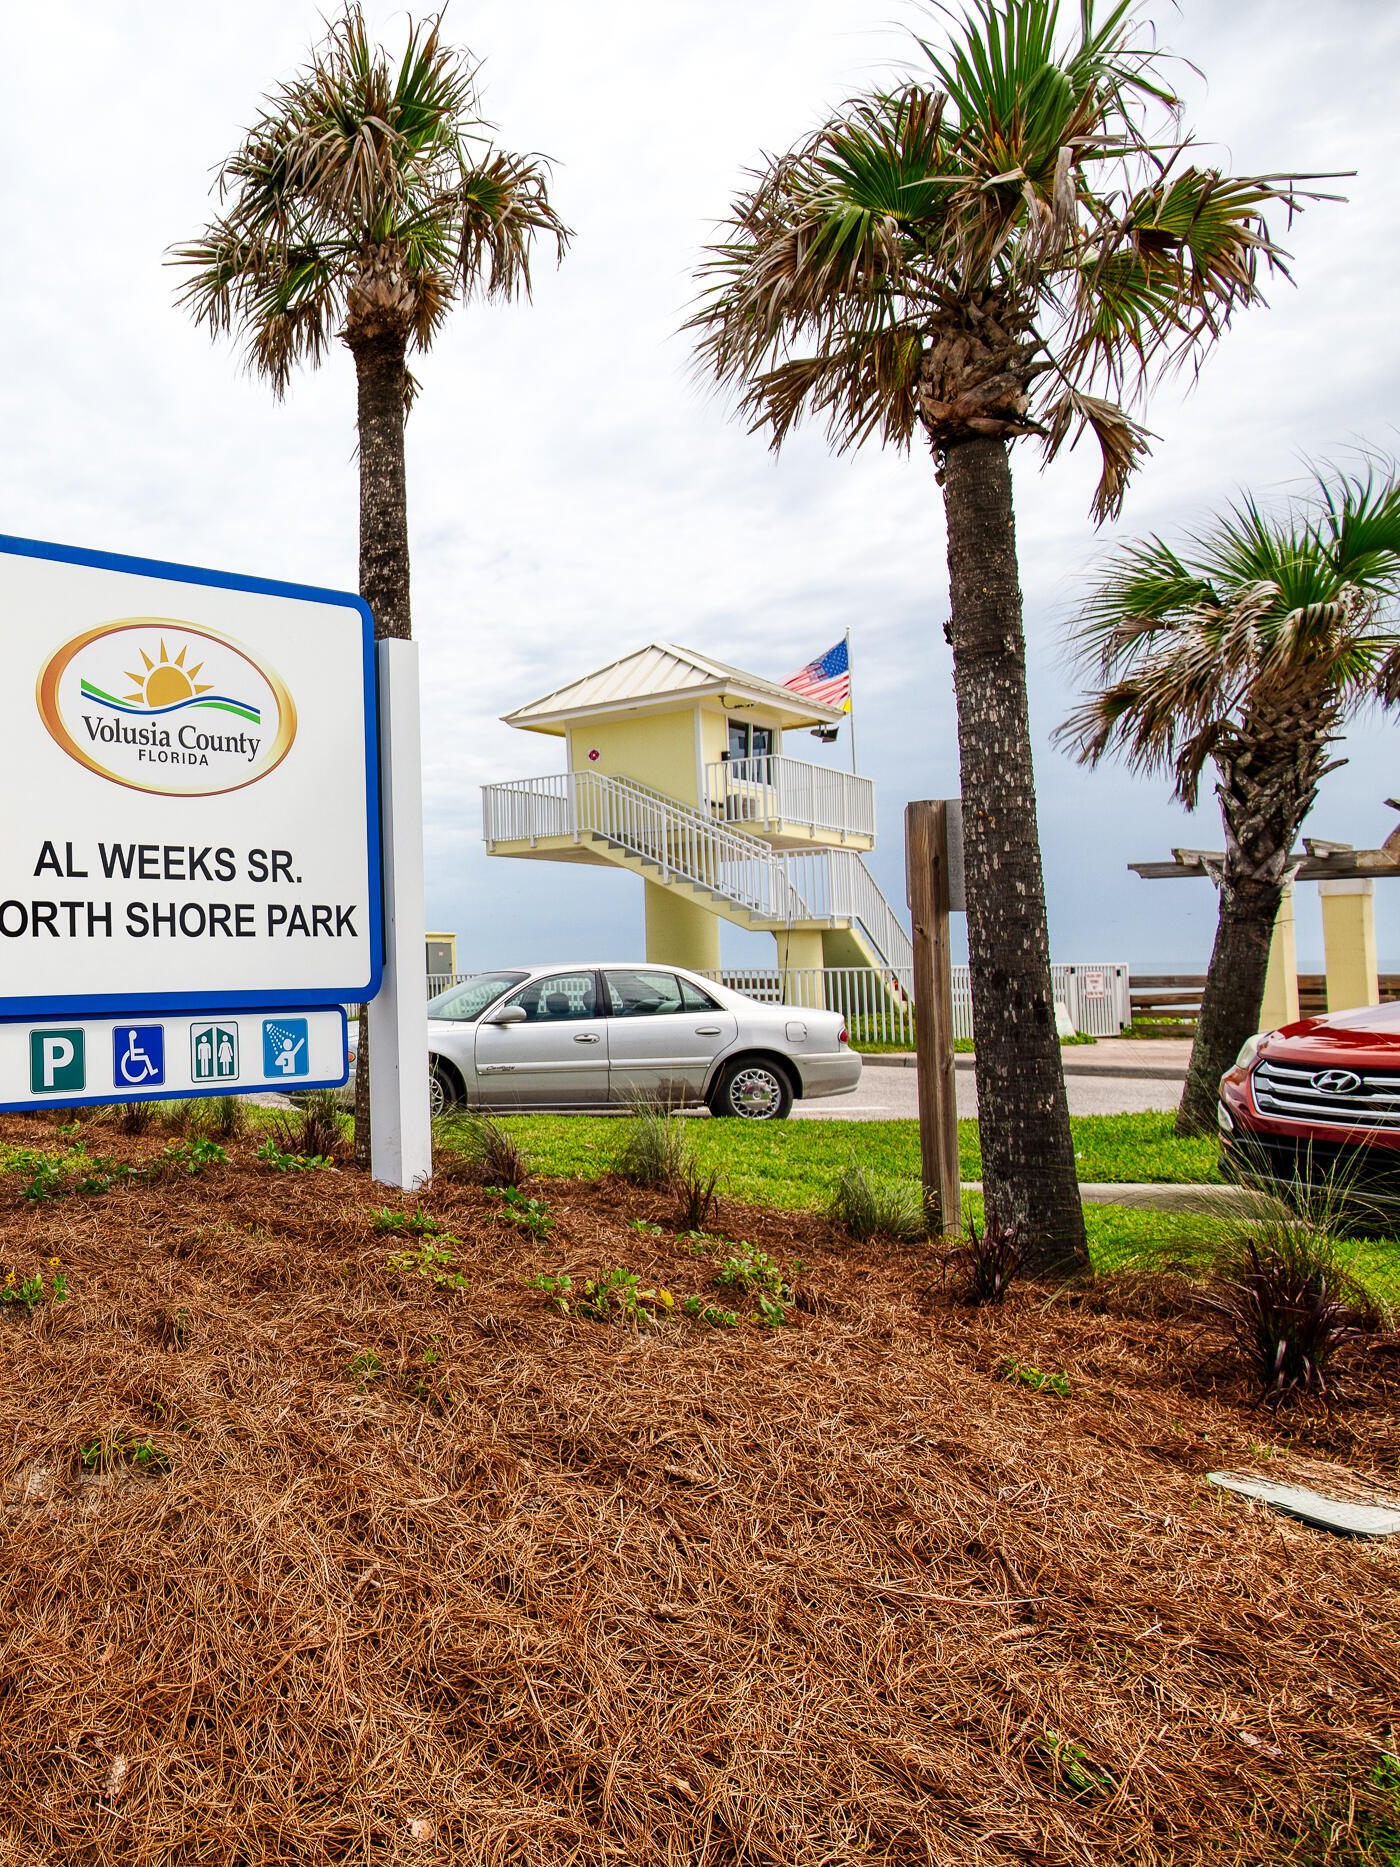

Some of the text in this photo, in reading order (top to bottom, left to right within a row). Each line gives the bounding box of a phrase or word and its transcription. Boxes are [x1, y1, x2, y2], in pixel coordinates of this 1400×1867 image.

[81, 715, 262, 763] Volusia County
[138, 748, 209, 766] FLORIDA
[33, 840, 303, 884] AL WEEKS SR.
[125, 901, 256, 938] SHORE
[266, 904, 358, 938] PARK
[42, 1036, 75, 1088] P
